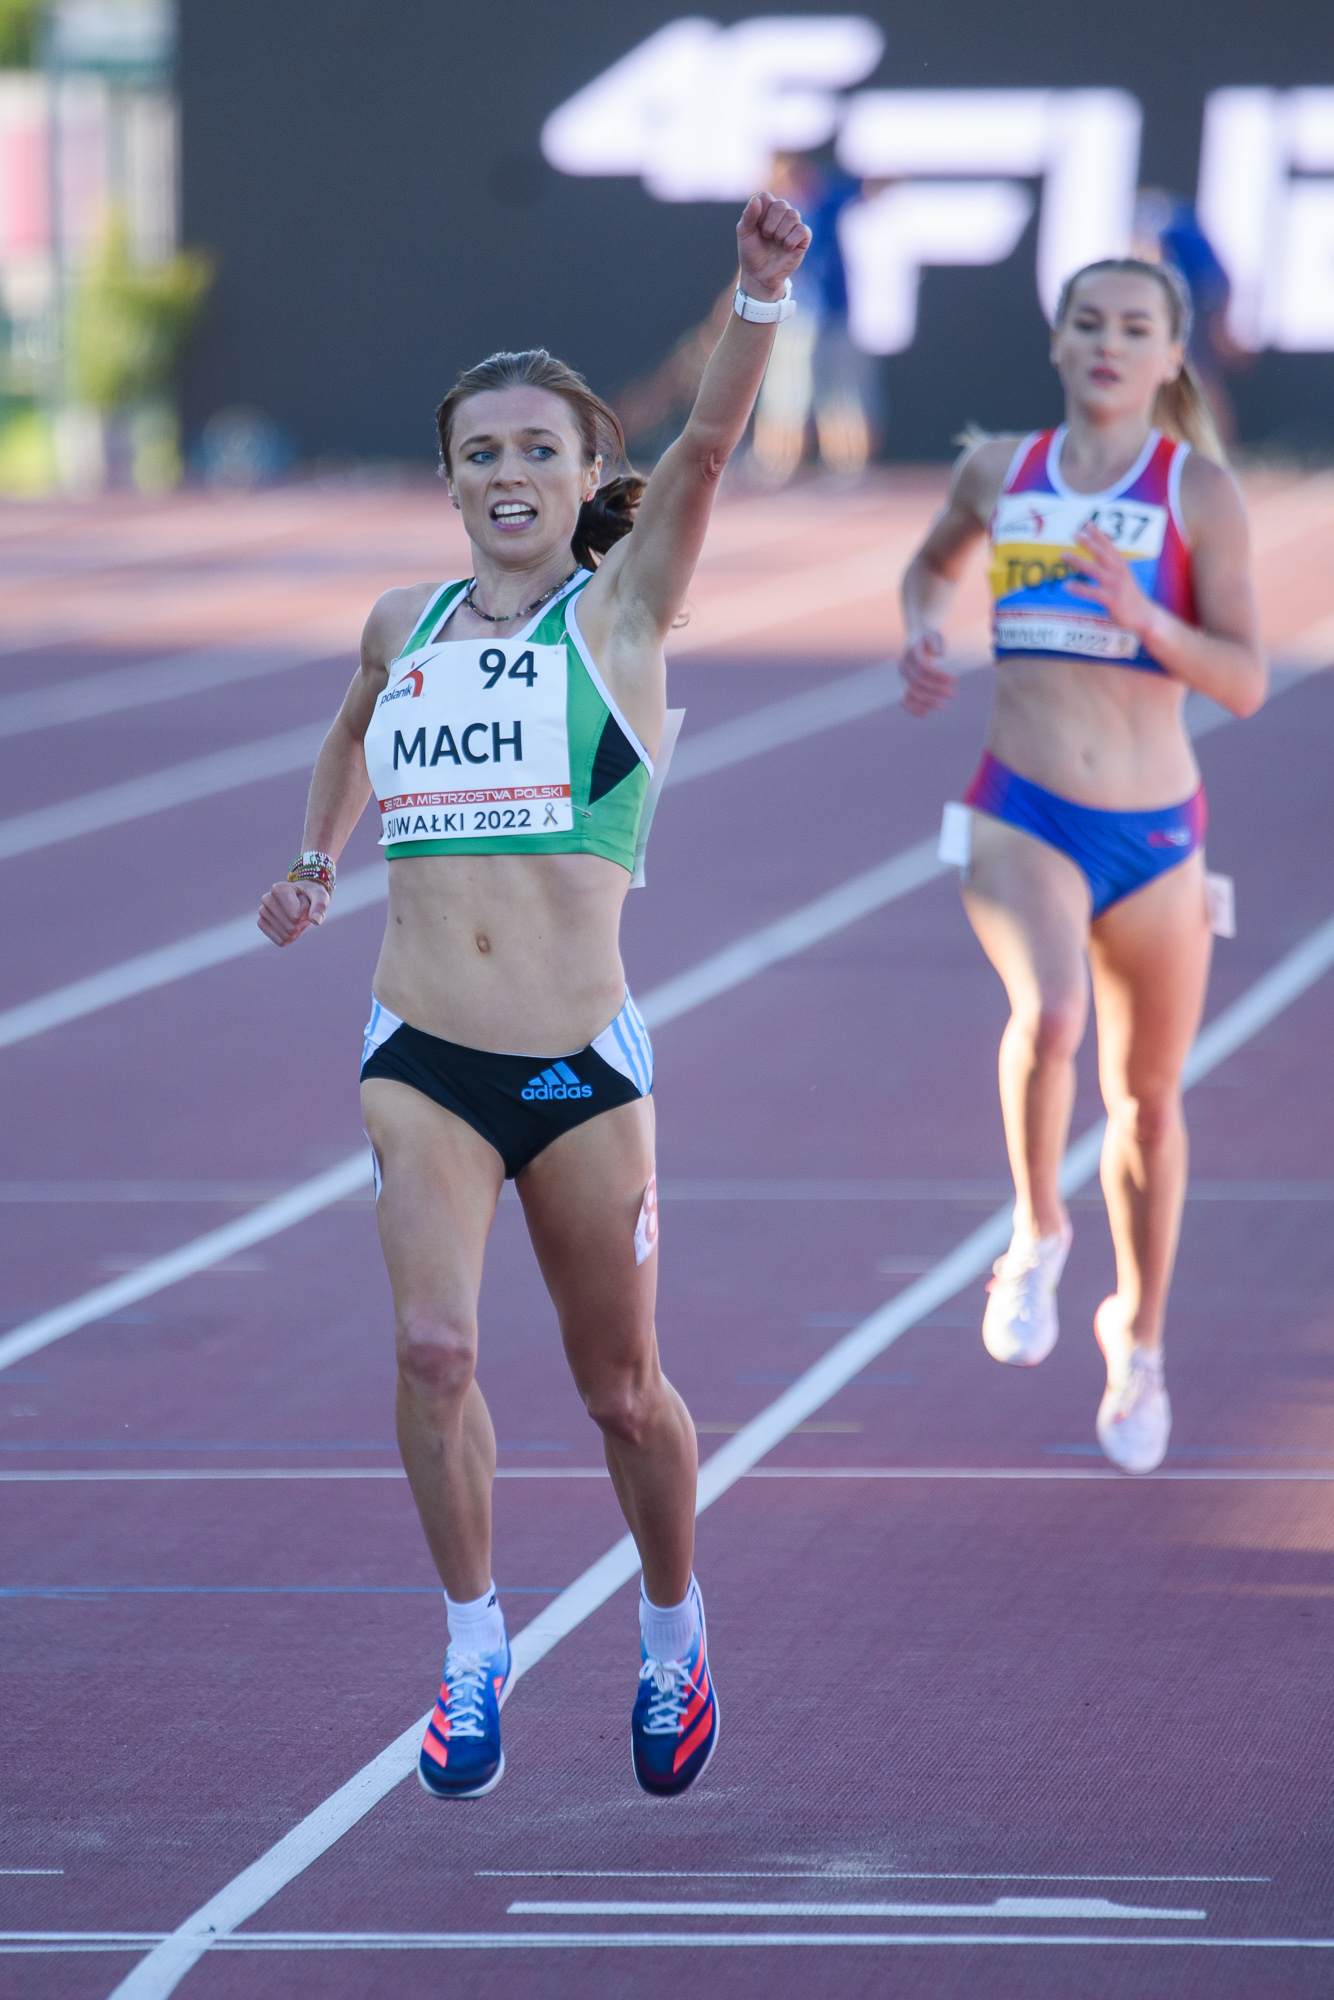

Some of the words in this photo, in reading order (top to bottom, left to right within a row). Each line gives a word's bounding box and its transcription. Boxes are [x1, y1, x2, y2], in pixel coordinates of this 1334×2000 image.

[478, 647, 538, 690] 94
[379, 683, 413, 708] polanik
[392, 720, 524, 771] MACH
[393, 796, 414, 809] PZLA
[416, 789, 512, 806] MISTRZOSTWA
[514, 786, 563, 800] POLSKI
[387, 812, 464, 840] SUWAŁKI
[473, 808, 532, 831] 2022
[520, 1082, 593, 1100] adidas
